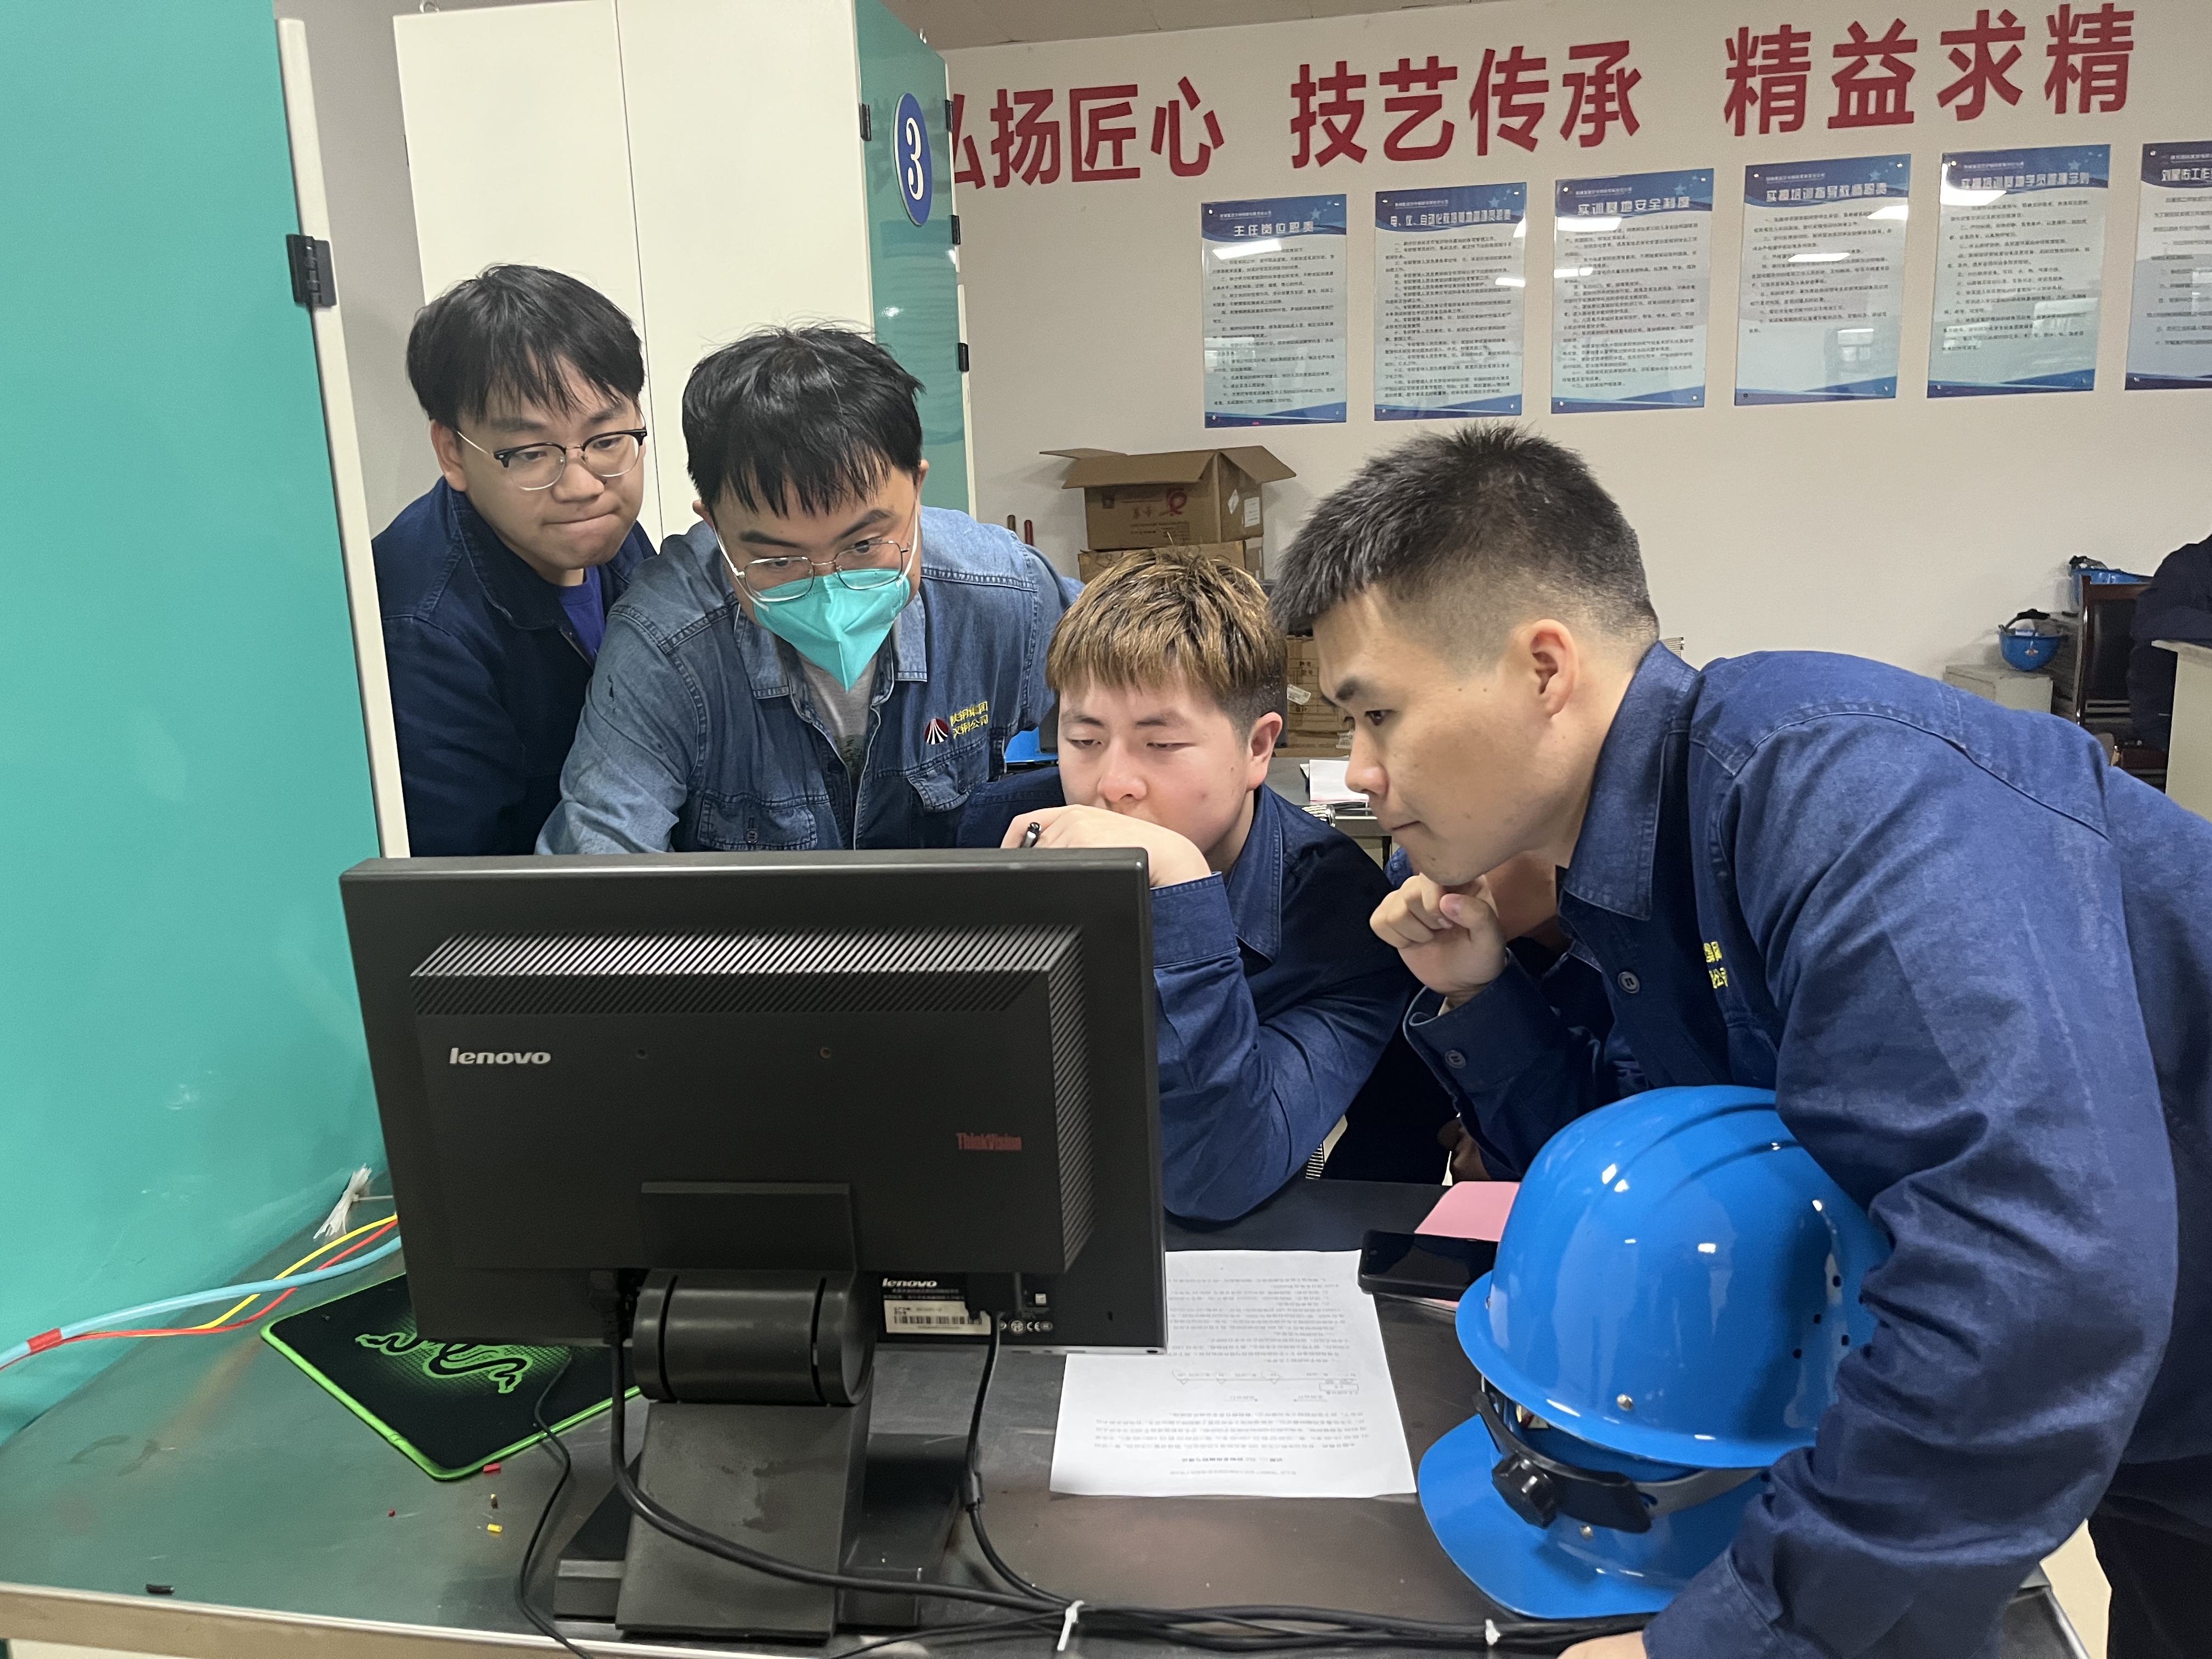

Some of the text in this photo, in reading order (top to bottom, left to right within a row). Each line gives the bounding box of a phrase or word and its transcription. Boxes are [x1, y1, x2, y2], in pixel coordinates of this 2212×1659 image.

[1290, 40, 1642, 169] 技艺传承
[1724, 2, 2134, 137] 精益求精
[906, 117, 924, 200] 3
[449, 1047, 551, 1064] lenovo
[882, 1278, 938, 1288] lenovo
